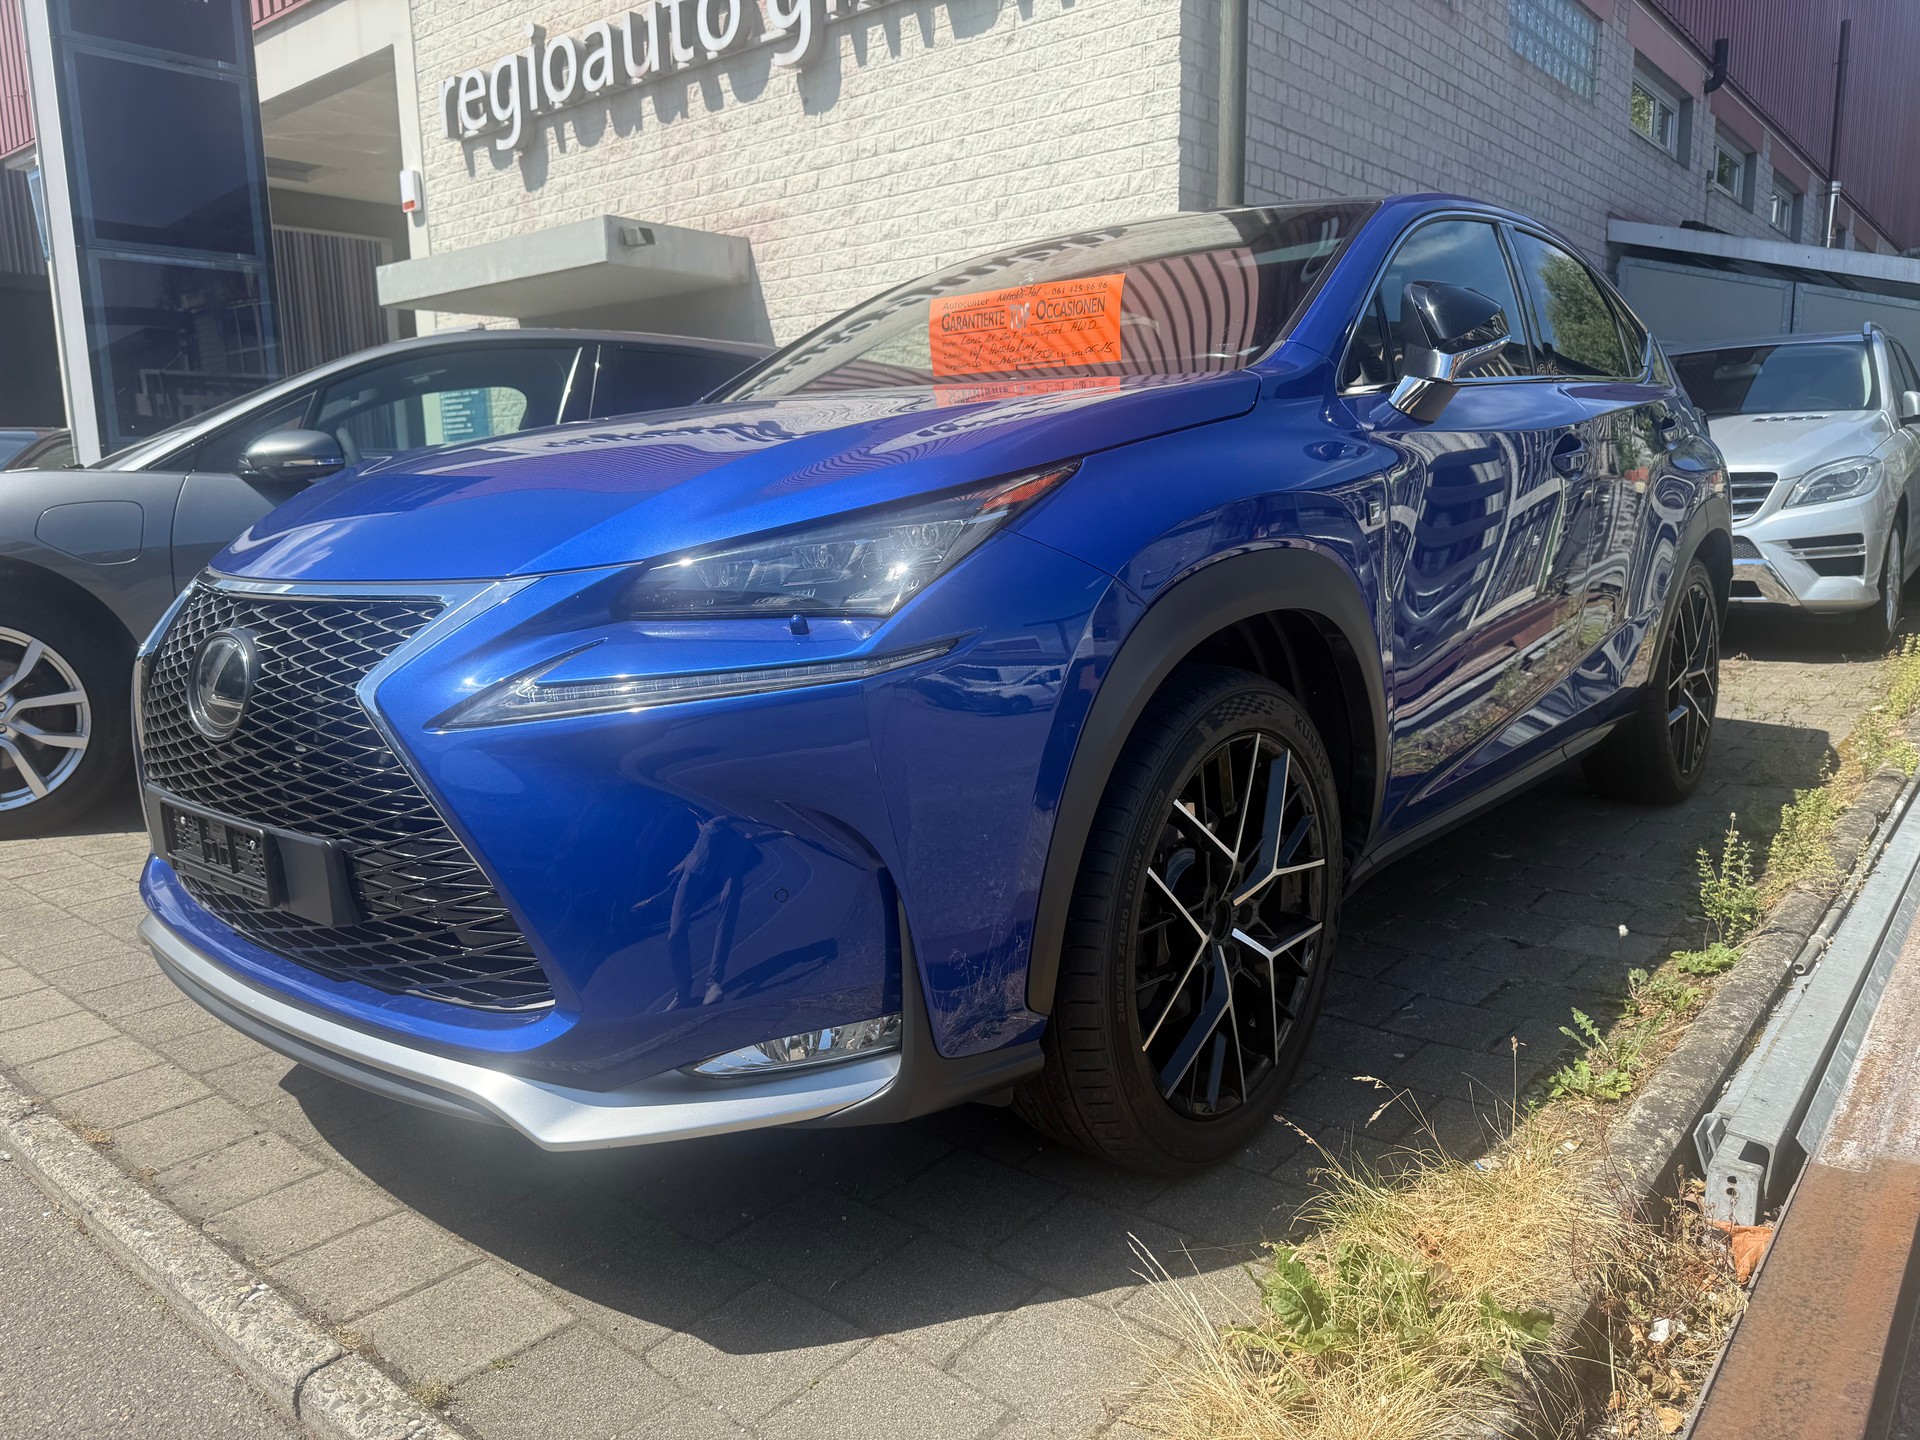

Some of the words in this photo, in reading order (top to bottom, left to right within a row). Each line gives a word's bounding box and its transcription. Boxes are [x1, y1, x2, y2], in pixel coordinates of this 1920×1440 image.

[437, 0, 743, 152] regioauto
[941, 309, 1005, 332] GARANTIERTE
[942, 298, 989, 310] Autocenter
[1051, 286, 1065, 296] 061
[1069, 284, 1083, 294] 425
[1084, 283, 1096, 291] 96
[1097, 281, 1108, 290] 96
[1294, 714, 1330, 780] KUMHO
[1125, 848, 1143, 902] 103W
[1117, 907, 1130, 957] ZR20
[1117, 959, 1127, 1025] 245/45
